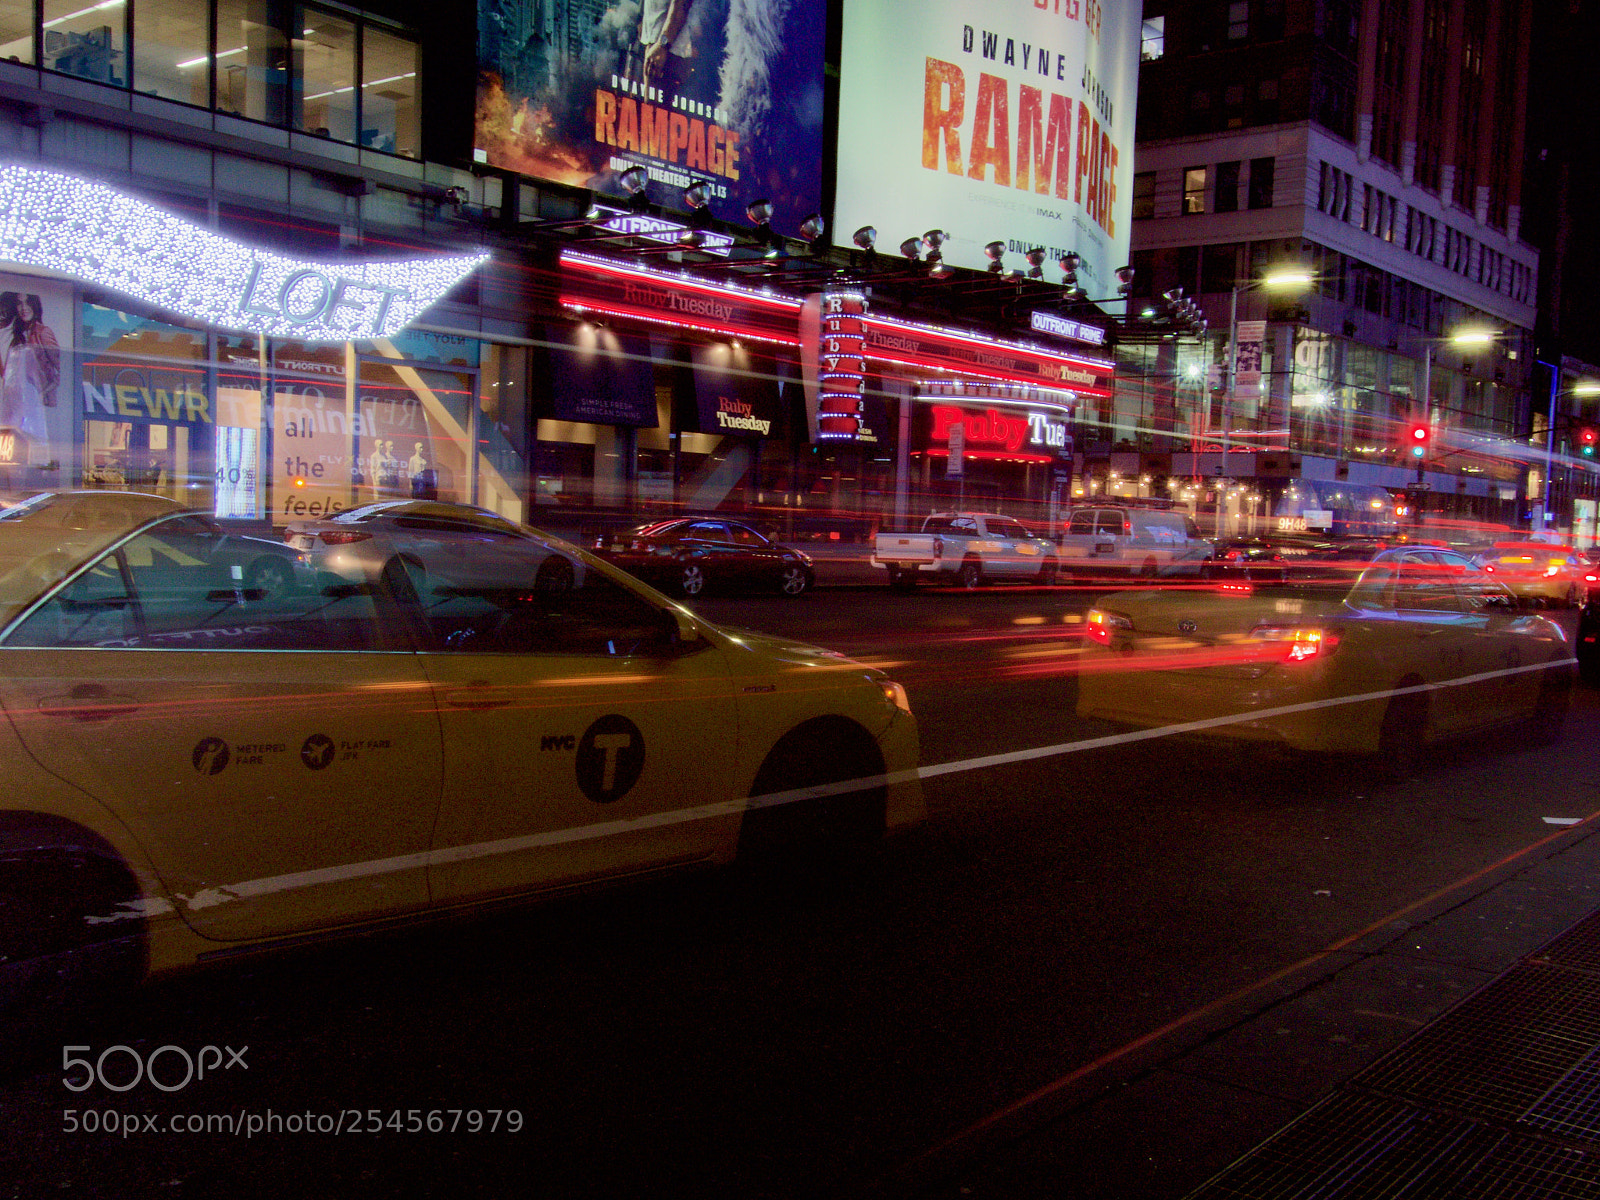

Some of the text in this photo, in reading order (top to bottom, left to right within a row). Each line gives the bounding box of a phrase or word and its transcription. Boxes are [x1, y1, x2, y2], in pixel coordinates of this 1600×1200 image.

[963, 25, 1065, 81] DWAYNE
[612, 74, 728, 124] DWAYNE JOHNSON
[595, 88, 740, 181] RAMPAGE
[921, 56, 1118, 240] RAMPAGE
[647, 166, 691, 189] THEATERS
[717, 185, 727, 198] 13
[1036, 207, 1063, 221] IMAX
[239, 260, 411, 334] LOFT
[624, 282, 733, 320] Ruby Tuesday
[1033, 314, 1103, 344] OUTFRONT PRIME
[870, 331, 920, 355] Tuesday
[975, 351, 1017, 371] Tuesday
[1037, 362, 1097, 387] Ruby Tuesday
[718, 396, 753, 418] Ruby
[285, 417, 313, 438] all
[717, 411, 771, 435] Tuesday
[285, 456, 325, 478] the
[284, 495, 344, 517] feels
[1278, 517, 1307, 531] 9H48
[236, 743, 286, 753] METERED
[341, 739, 391, 750] FLAT FARE
[236, 756, 264, 765] FARE
[541, 733, 632, 792] NYC T
